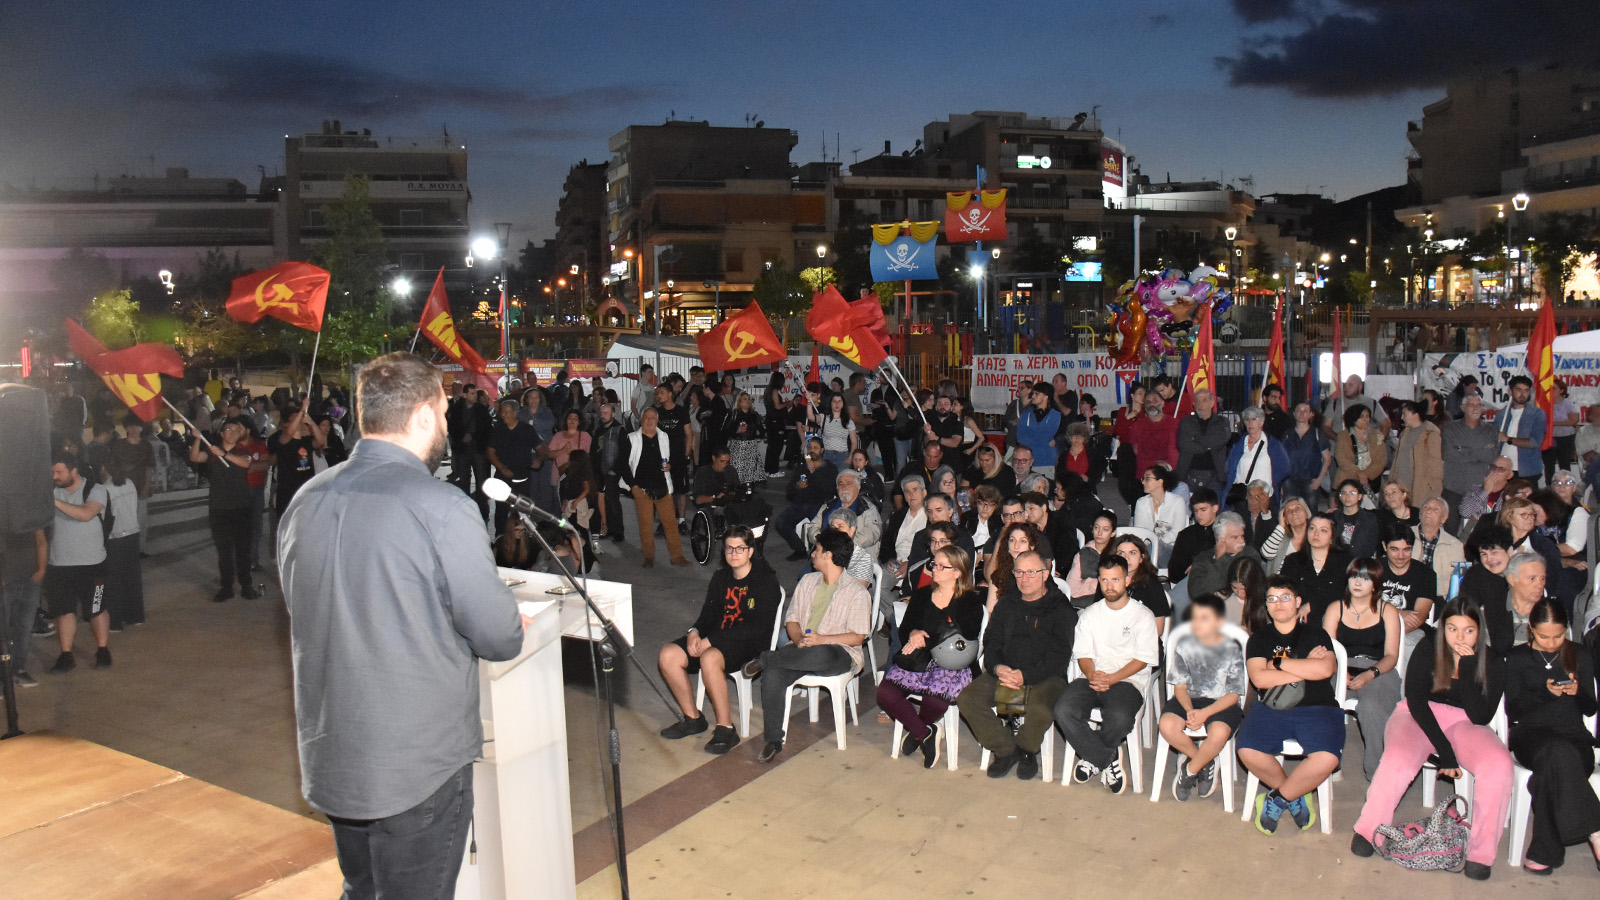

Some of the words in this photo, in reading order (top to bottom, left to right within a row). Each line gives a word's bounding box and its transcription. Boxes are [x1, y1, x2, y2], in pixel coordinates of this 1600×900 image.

[977, 356, 1007, 371] ΚΑΤΩ
[1013, 359, 1023, 370] ΤΑ
[1027, 355, 1058, 369] ΧΕΡΙΑ
[1061, 360, 1075, 369] ΑΠΟ
[1078, 359, 1091, 369] ΤΗΝ
[1077, 373, 1109, 388] ΟΠΛΟ
